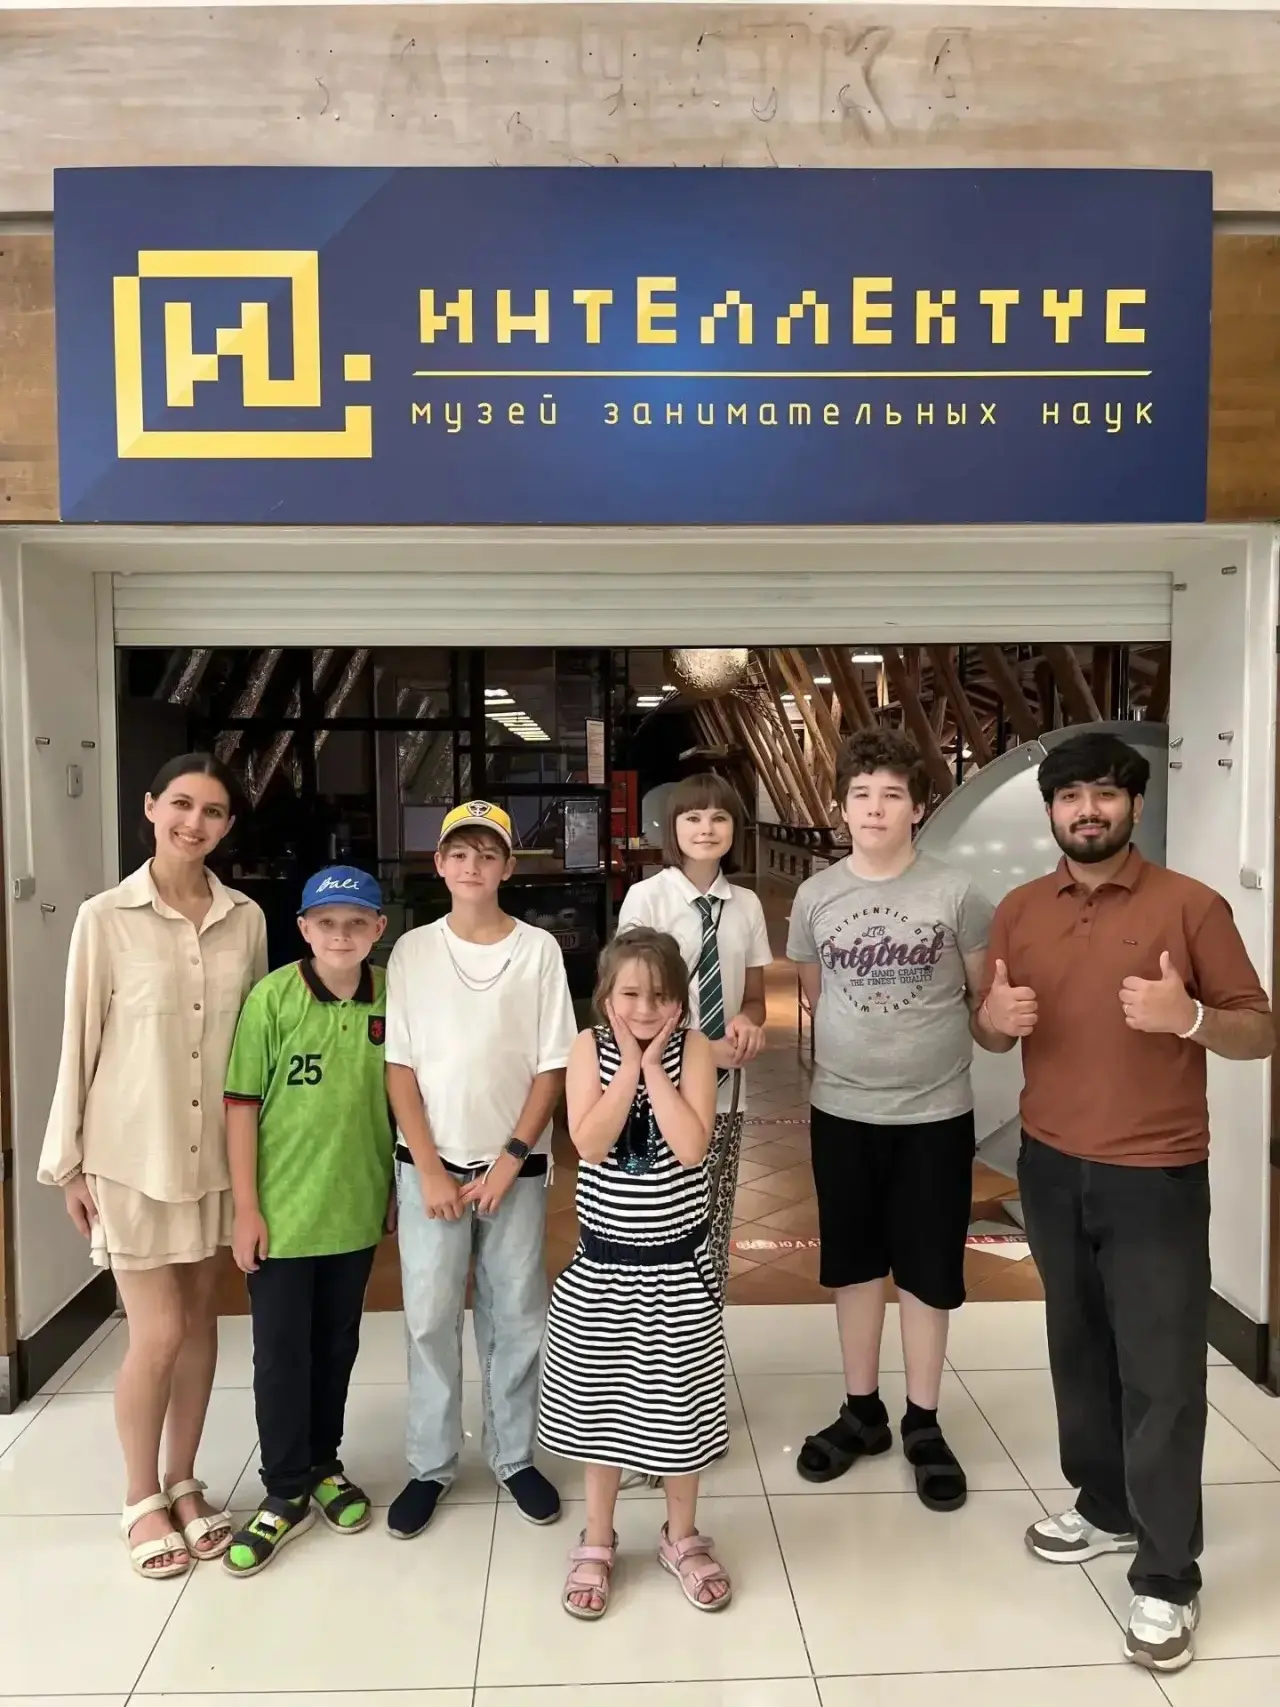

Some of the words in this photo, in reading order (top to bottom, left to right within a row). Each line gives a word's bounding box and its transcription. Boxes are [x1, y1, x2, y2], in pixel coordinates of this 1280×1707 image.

[419, 276, 1147, 346] ИНТЕЛЛЕКТУС
[411, 395, 559, 432] музей
[603, 401, 1000, 426] занимательных
[1042, 402, 1155, 433] наук
[829, 907, 908, 941] AUTHENTIC
[286, 1053, 323, 1086] 25
